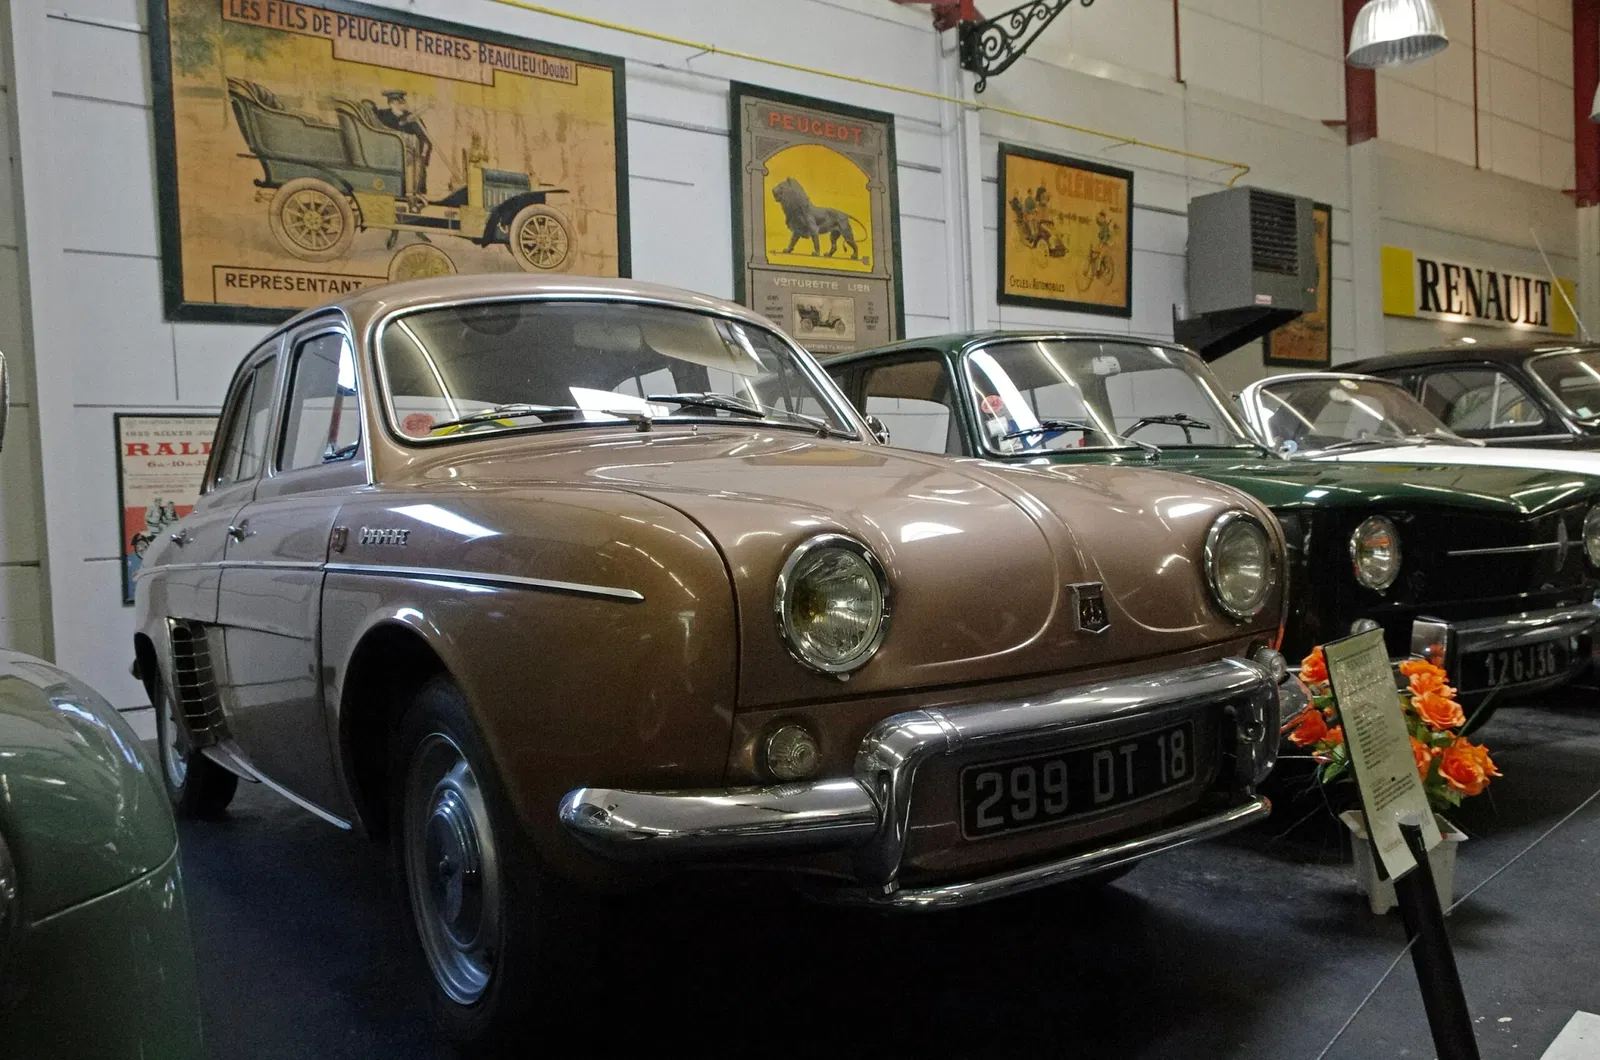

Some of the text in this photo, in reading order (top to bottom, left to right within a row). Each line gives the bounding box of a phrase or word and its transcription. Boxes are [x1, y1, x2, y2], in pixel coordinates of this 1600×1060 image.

[229, 0, 261, 21] LES
[267, 1, 308, 30] FILS
[337, 15, 411, 49] PEUGEOT
[768, 111, 865, 144] PEUGEOT
[773, 277, 871, 293] VOITURETTE LION
[1417, 258, 1551, 327] RENAULT
[975, 729, 1187, 829] 299 DT 18
